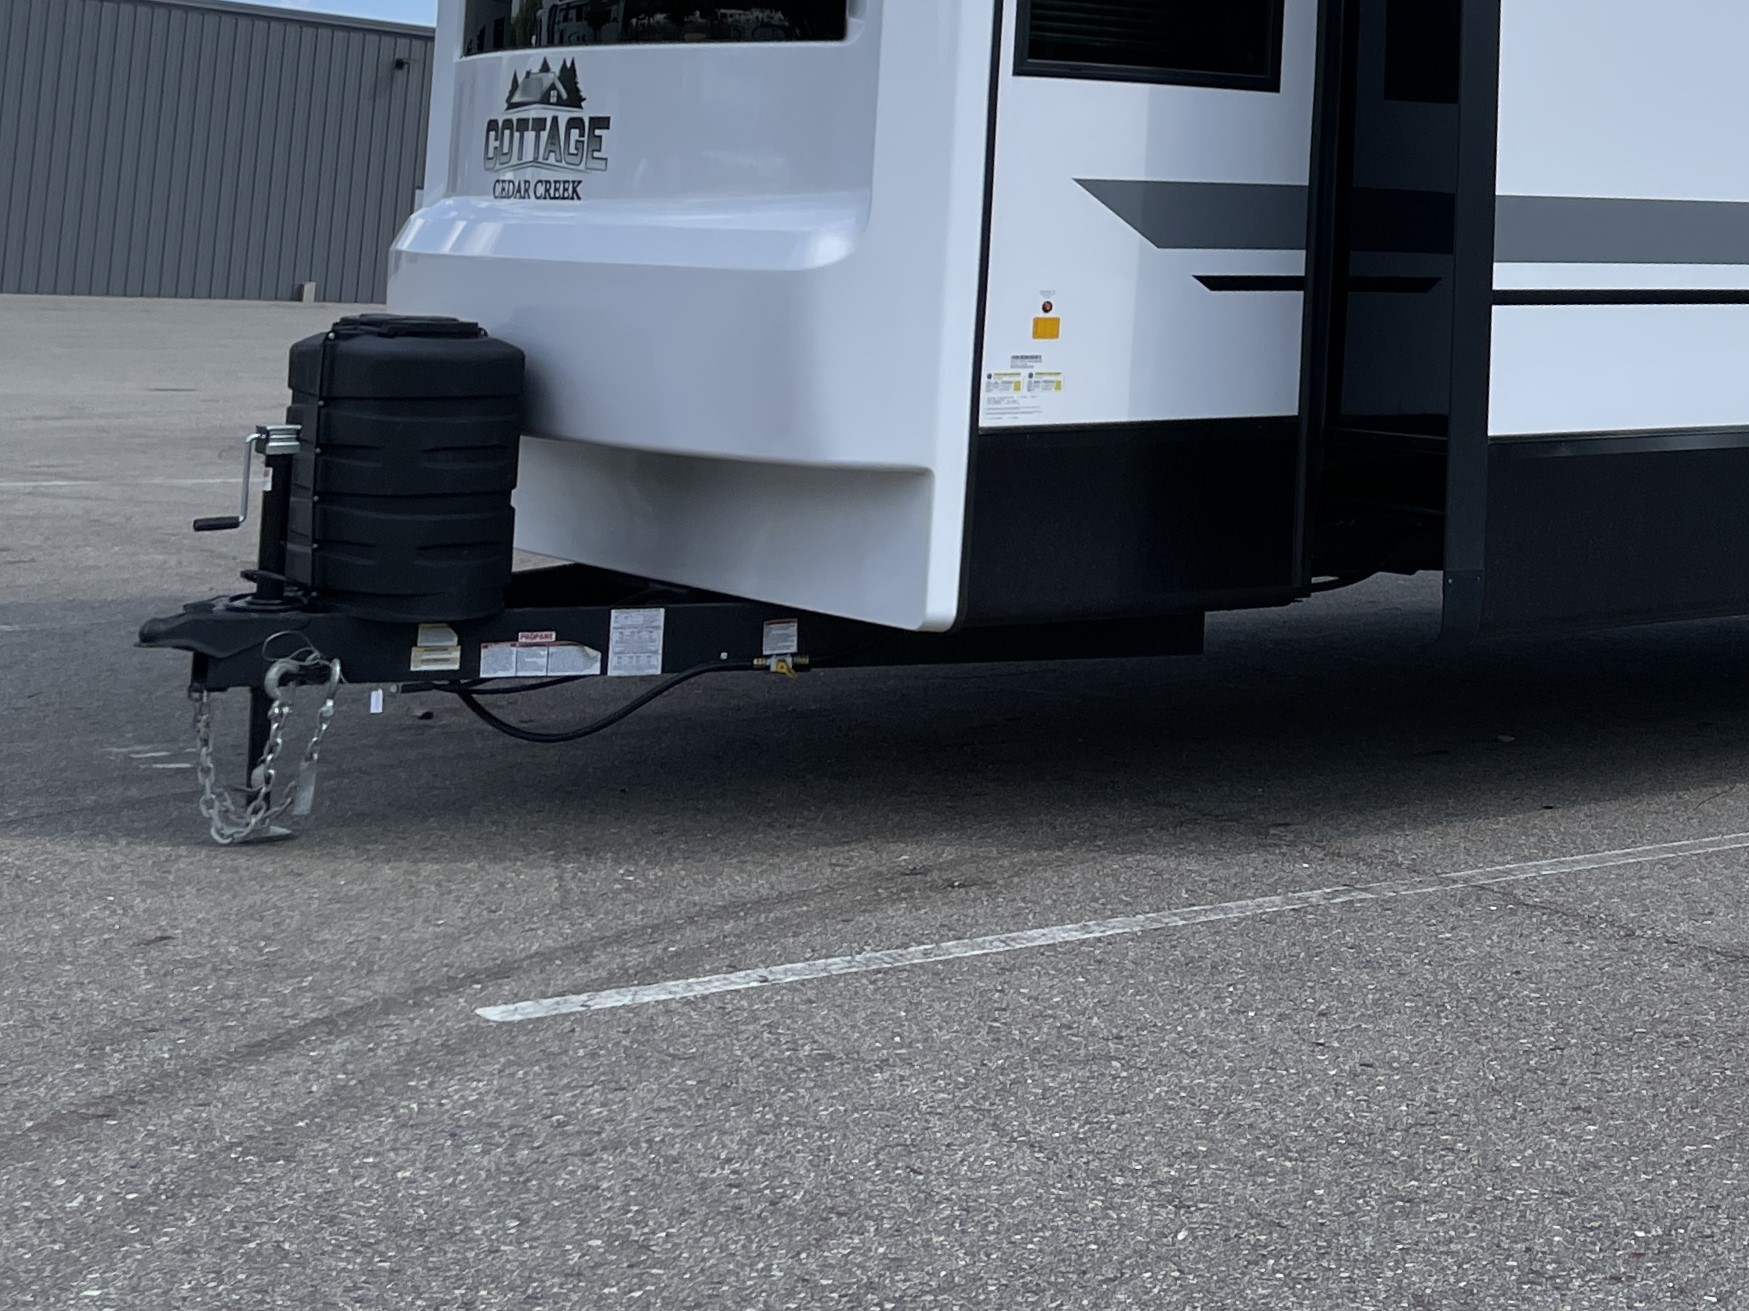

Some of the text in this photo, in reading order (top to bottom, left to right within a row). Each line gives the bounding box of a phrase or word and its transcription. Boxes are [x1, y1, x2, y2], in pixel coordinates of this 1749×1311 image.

[483, 115, 611, 171] COTTAGE
[493, 179, 582, 200] CEDAR CREEK
